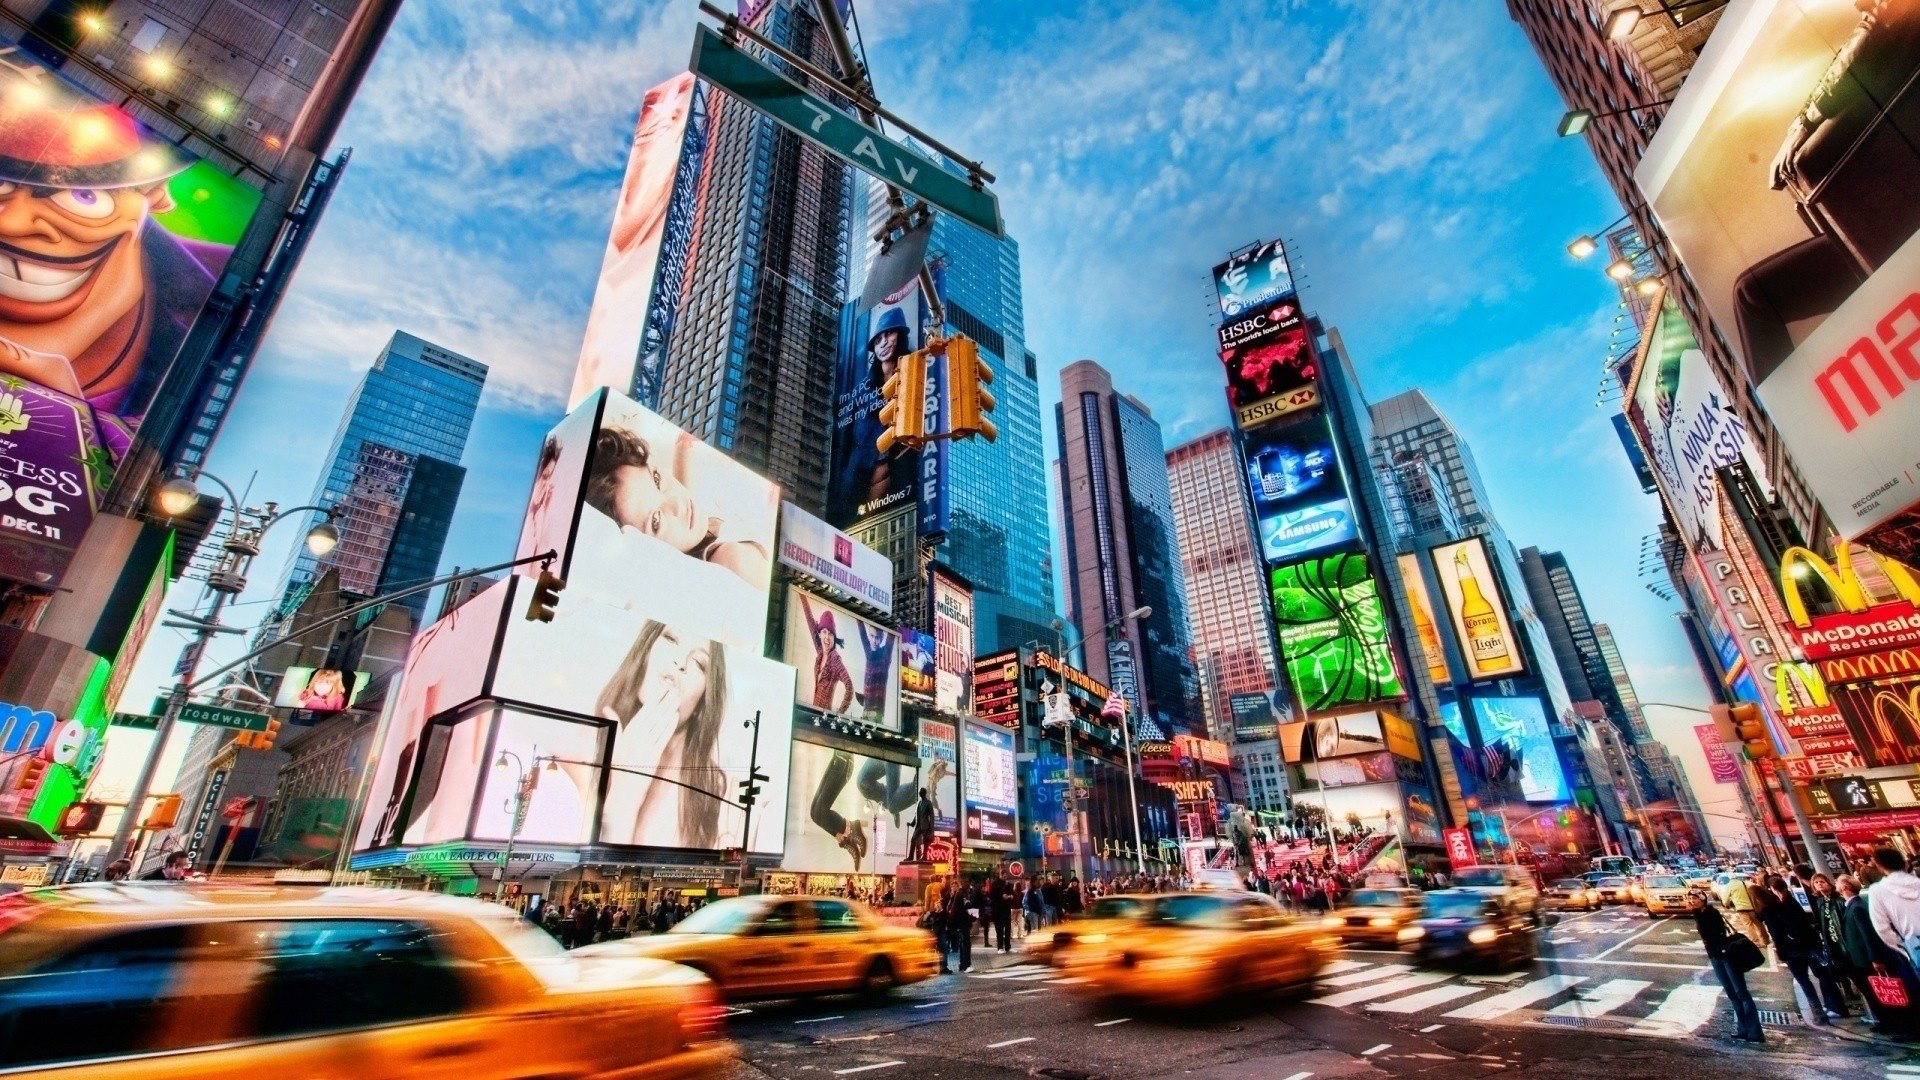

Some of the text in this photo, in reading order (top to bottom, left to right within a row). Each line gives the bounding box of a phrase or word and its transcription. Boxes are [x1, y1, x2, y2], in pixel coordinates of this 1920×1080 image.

[802, 98, 918, 184] 7 Av
[1242, 282, 1292, 308] Prudential
[1220, 315, 1267, 342] HSBC
[1223, 317, 1299, 349] The world's local bank
[838, 400, 854, 417] and
[838, 415, 853, 429] was
[855, 407, 868, 420] my
[1240, 397, 1288, 423] HSBC
[922, 377, 939, 500] SQUARE
[1681, 402, 1719, 473] NINJA
[867, 485, 912, 512] Windows 7
[1852, 478, 1900, 510] RECORDABLE
[923, 513, 937, 524] NYC
[1857, 501, 1881, 517] MEDIA
[45, 525, 60, 539] 11
[1278, 517, 1338, 540] SAMSUNG
[783, 540, 890, 606] READY FOR HOLIDAY CHEER
[937, 601, 970, 628] MUSICAL
[944, 594, 962, 612] BEST
[938, 615, 960, 649] BILLY
[923, 721, 954, 742] HEIGHTS
[1803, 742, 1831, 750] OPEN
[1833, 739, 1845, 747] 24
[408, 852, 448, 862] AMERICAN
[449, 851, 484, 861] EAGLE
[1449, 831, 1468, 860] tkts
